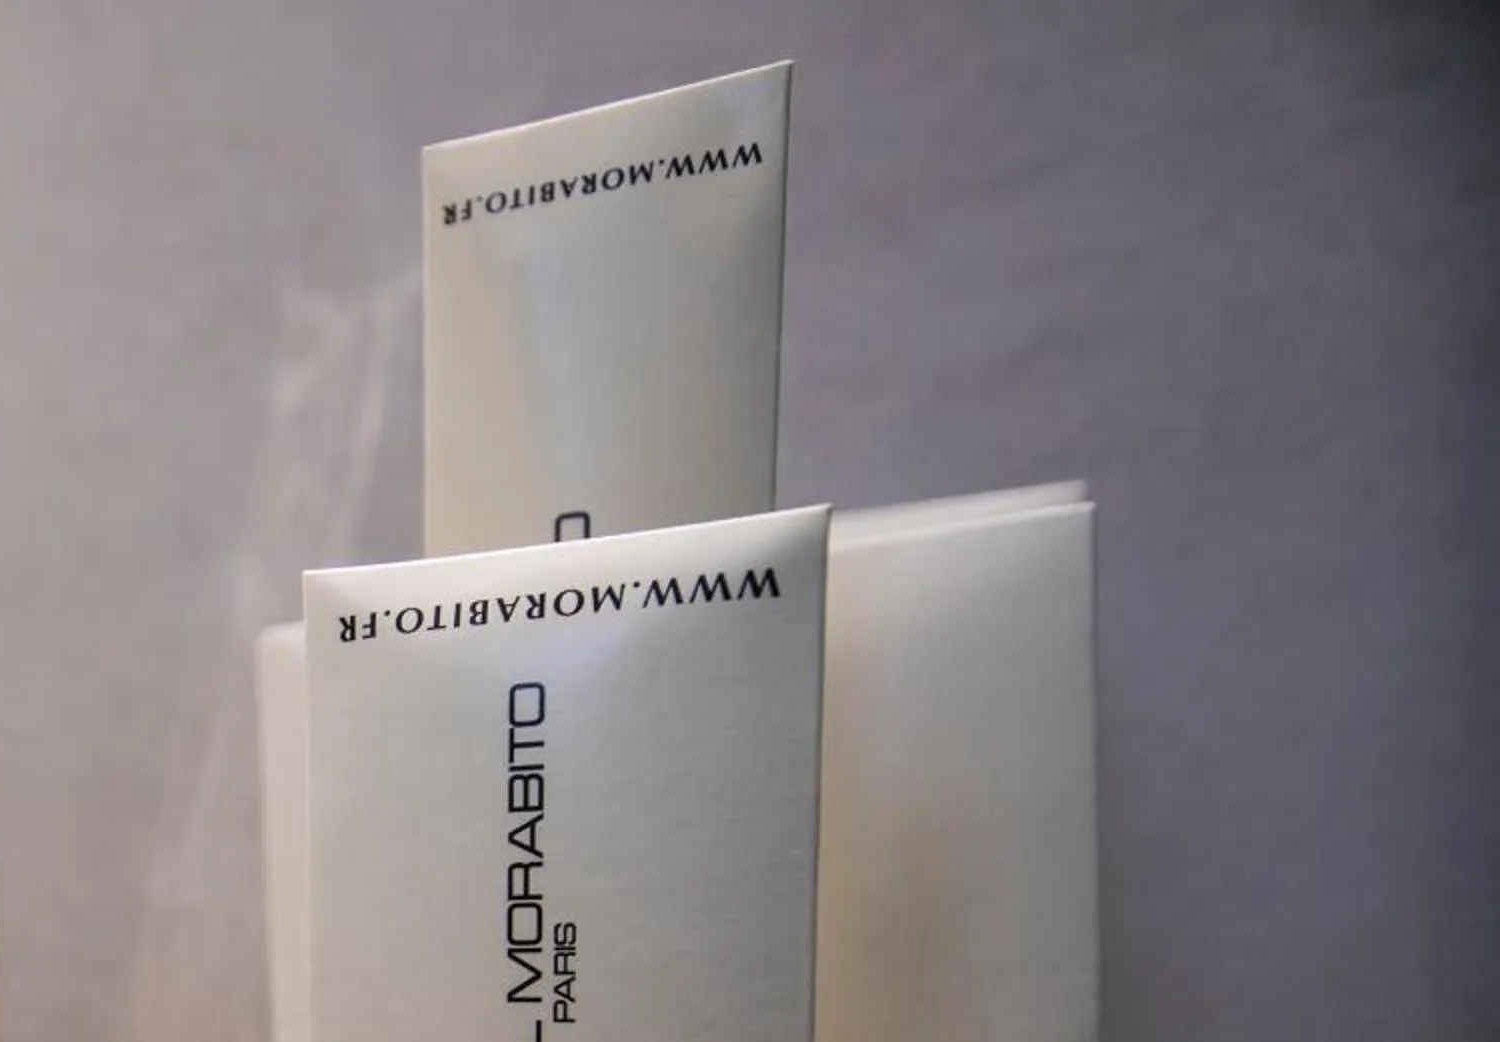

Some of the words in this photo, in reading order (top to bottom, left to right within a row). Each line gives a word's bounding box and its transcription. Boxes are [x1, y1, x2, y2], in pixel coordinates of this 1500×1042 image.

[443, 142, 763, 226] WWW.MORABITO.FR
[339, 567, 781, 643] WWW.MORABITO.FR
[507, 682, 545, 1003] MORABITO
[553, 922, 577, 1023] PARIS
